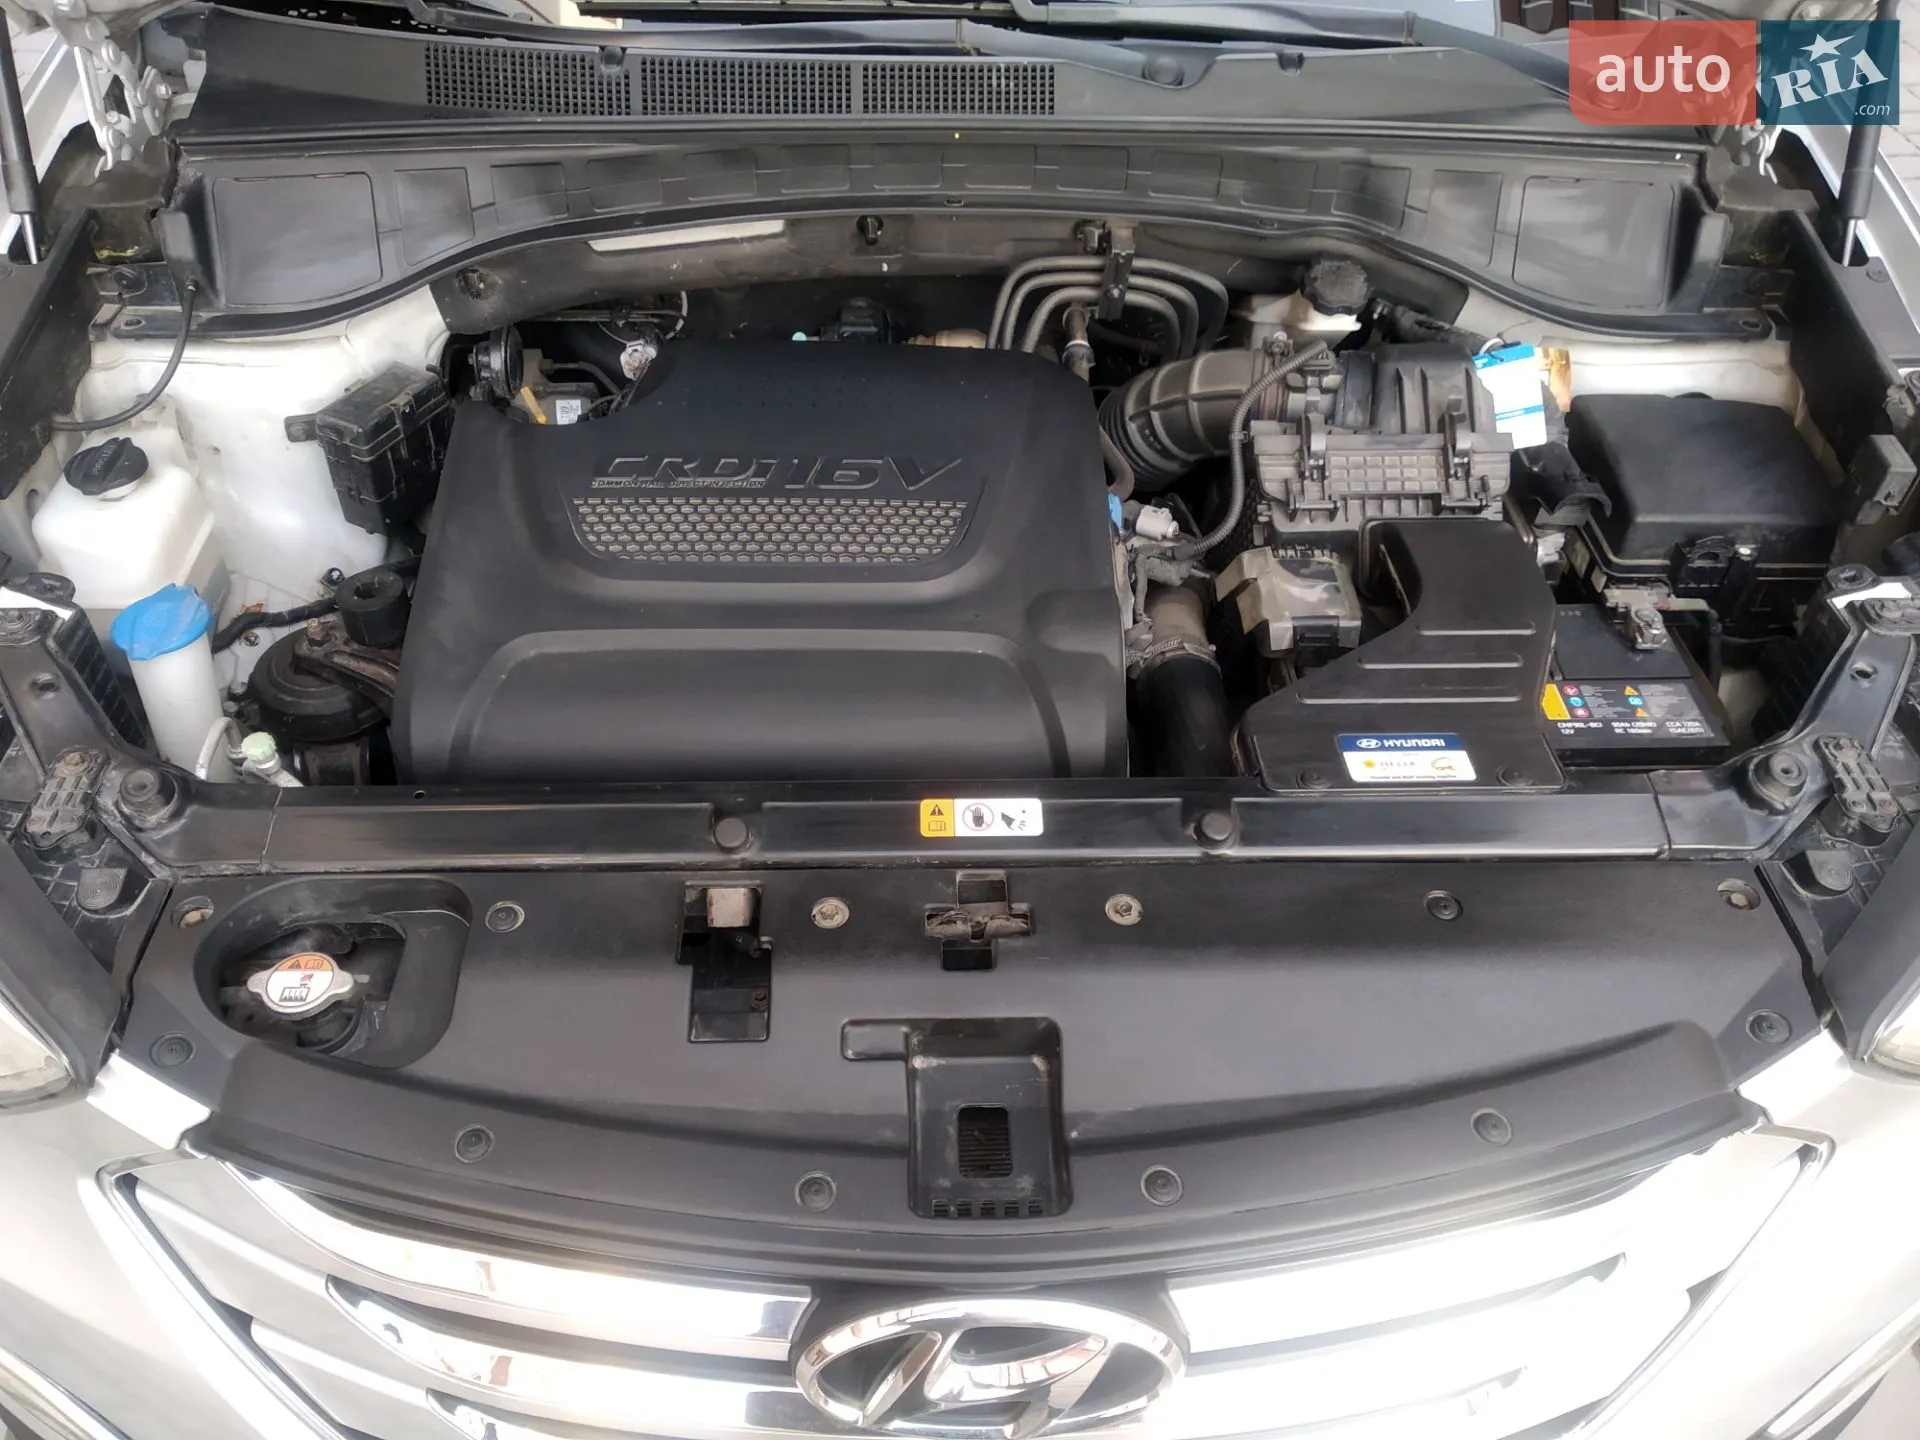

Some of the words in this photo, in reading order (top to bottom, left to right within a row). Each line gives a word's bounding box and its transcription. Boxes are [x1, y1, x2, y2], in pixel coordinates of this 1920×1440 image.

[591, 480, 638, 489] COMMON
[667, 480, 708, 489] DIRECT
[709, 480, 767, 489] INJECTION
[1383, 738, 1445, 747] HYUNDAI
